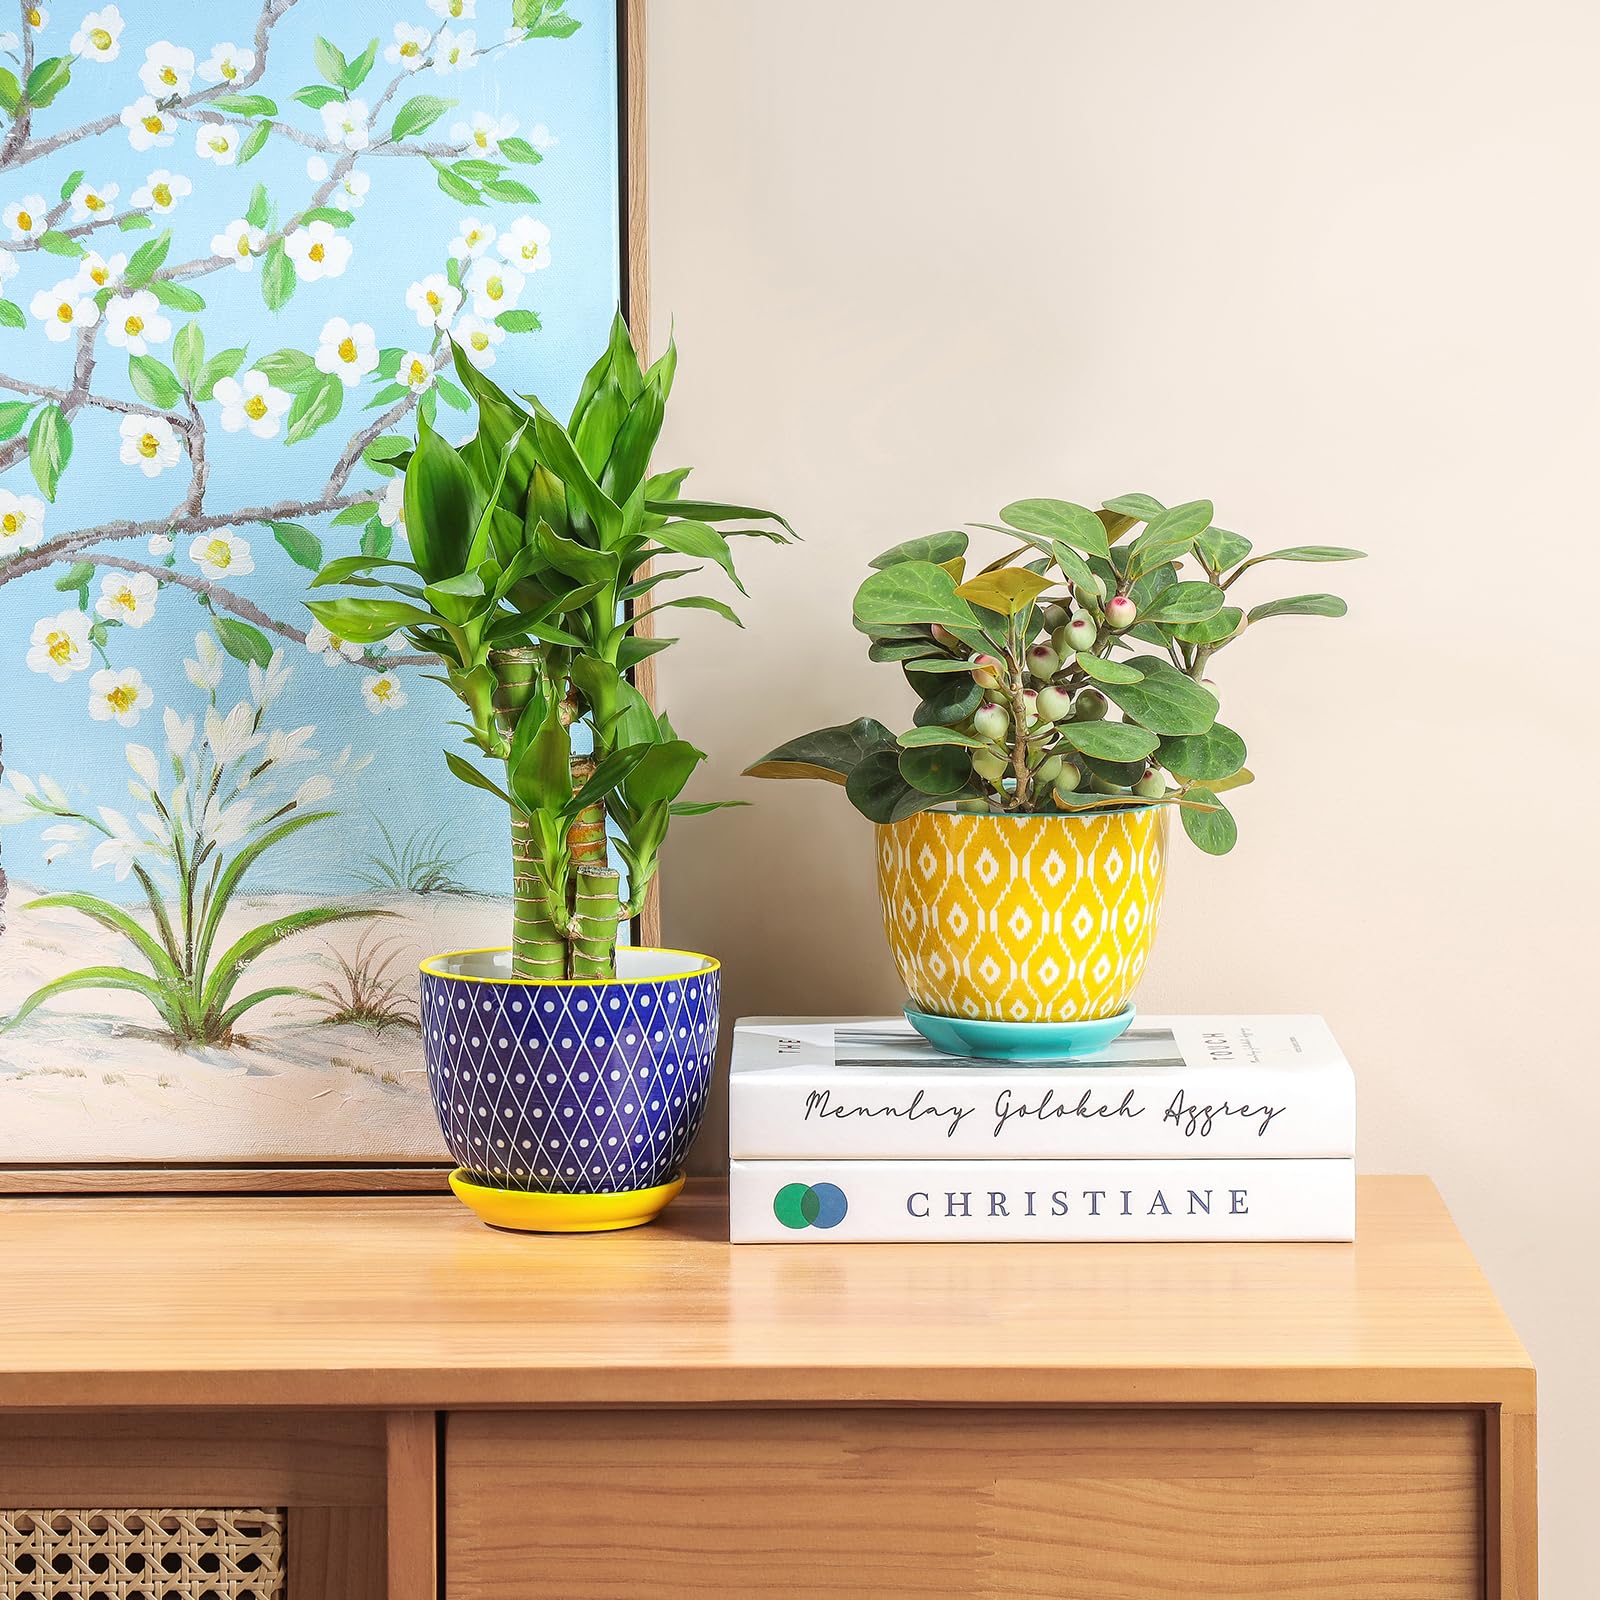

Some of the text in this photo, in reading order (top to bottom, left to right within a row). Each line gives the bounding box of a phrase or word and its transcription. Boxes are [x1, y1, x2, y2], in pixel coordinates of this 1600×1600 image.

[778, 1039, 801, 1054] THE
[1201, 1032, 1236, 1061] TOUCH
[804, 1088, 1287, 1138] Mennlay Golokeh Aggrey
[906, 1189, 1249, 1218] CHRISTIANE
